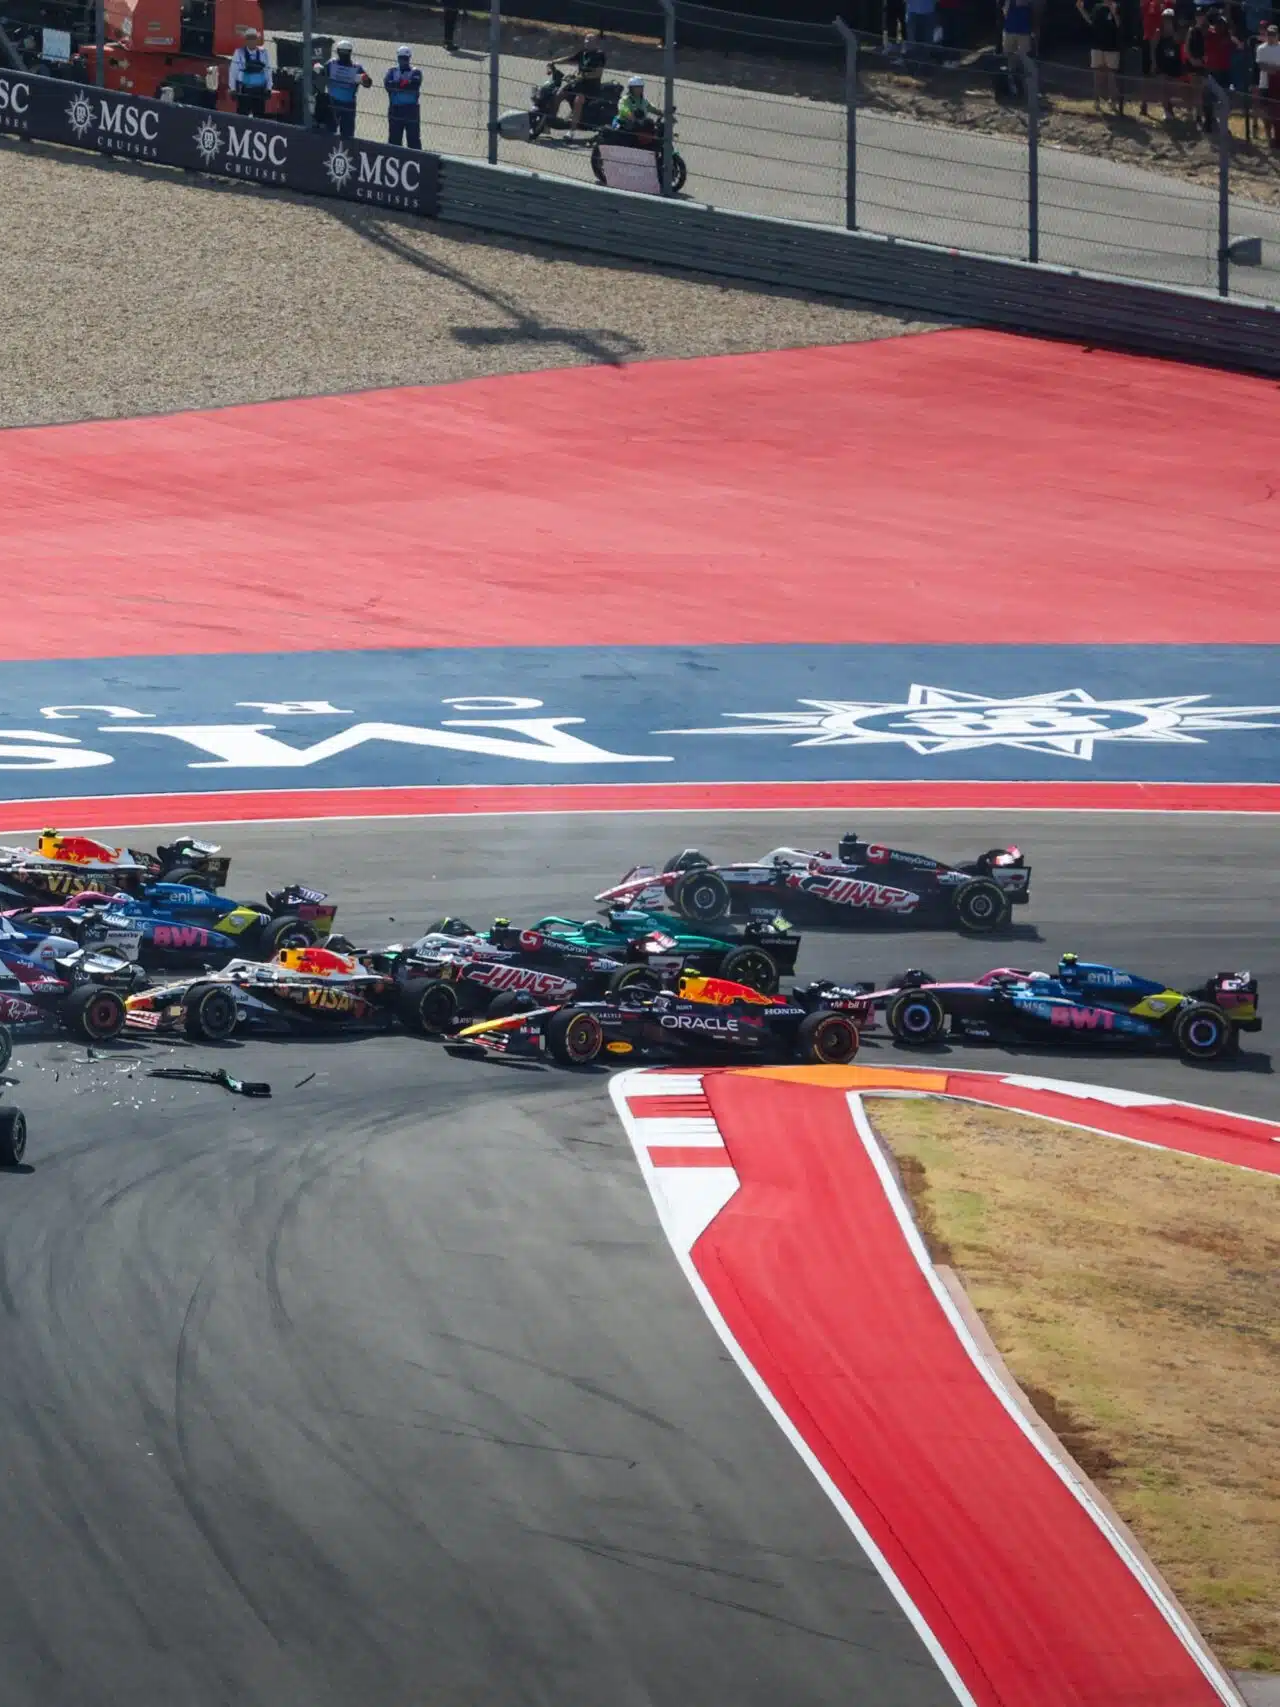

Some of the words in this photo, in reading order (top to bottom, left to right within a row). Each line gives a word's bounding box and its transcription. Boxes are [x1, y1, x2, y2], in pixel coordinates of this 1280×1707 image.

[97, 100, 158, 140] MSC
[95, 135, 157, 157] CRUISES
[226, 126, 287, 165] MSC
[225, 162, 286, 183] CRUISES
[358, 152, 421, 191] MSC
[356, 188, 418, 208] CRUISES
[890, 852, 938, 868] MoneyGram
[47, 874, 106, 896] VISA
[808, 878, 908, 908] HAAS
[169, 889, 191, 903] eni
[154, 926, 208, 947] BWT
[543, 938, 588, 954] MoneyGram
[467, 966, 566, 996] HAAS
[1087, 970, 1110, 985] eni
[308, 988, 350, 1011] VISA
[764, 1007, 806, 1015] HONDA
[1050, 1005, 1116, 1030] BWT
[660, 1014, 739, 1032] ORACLE
